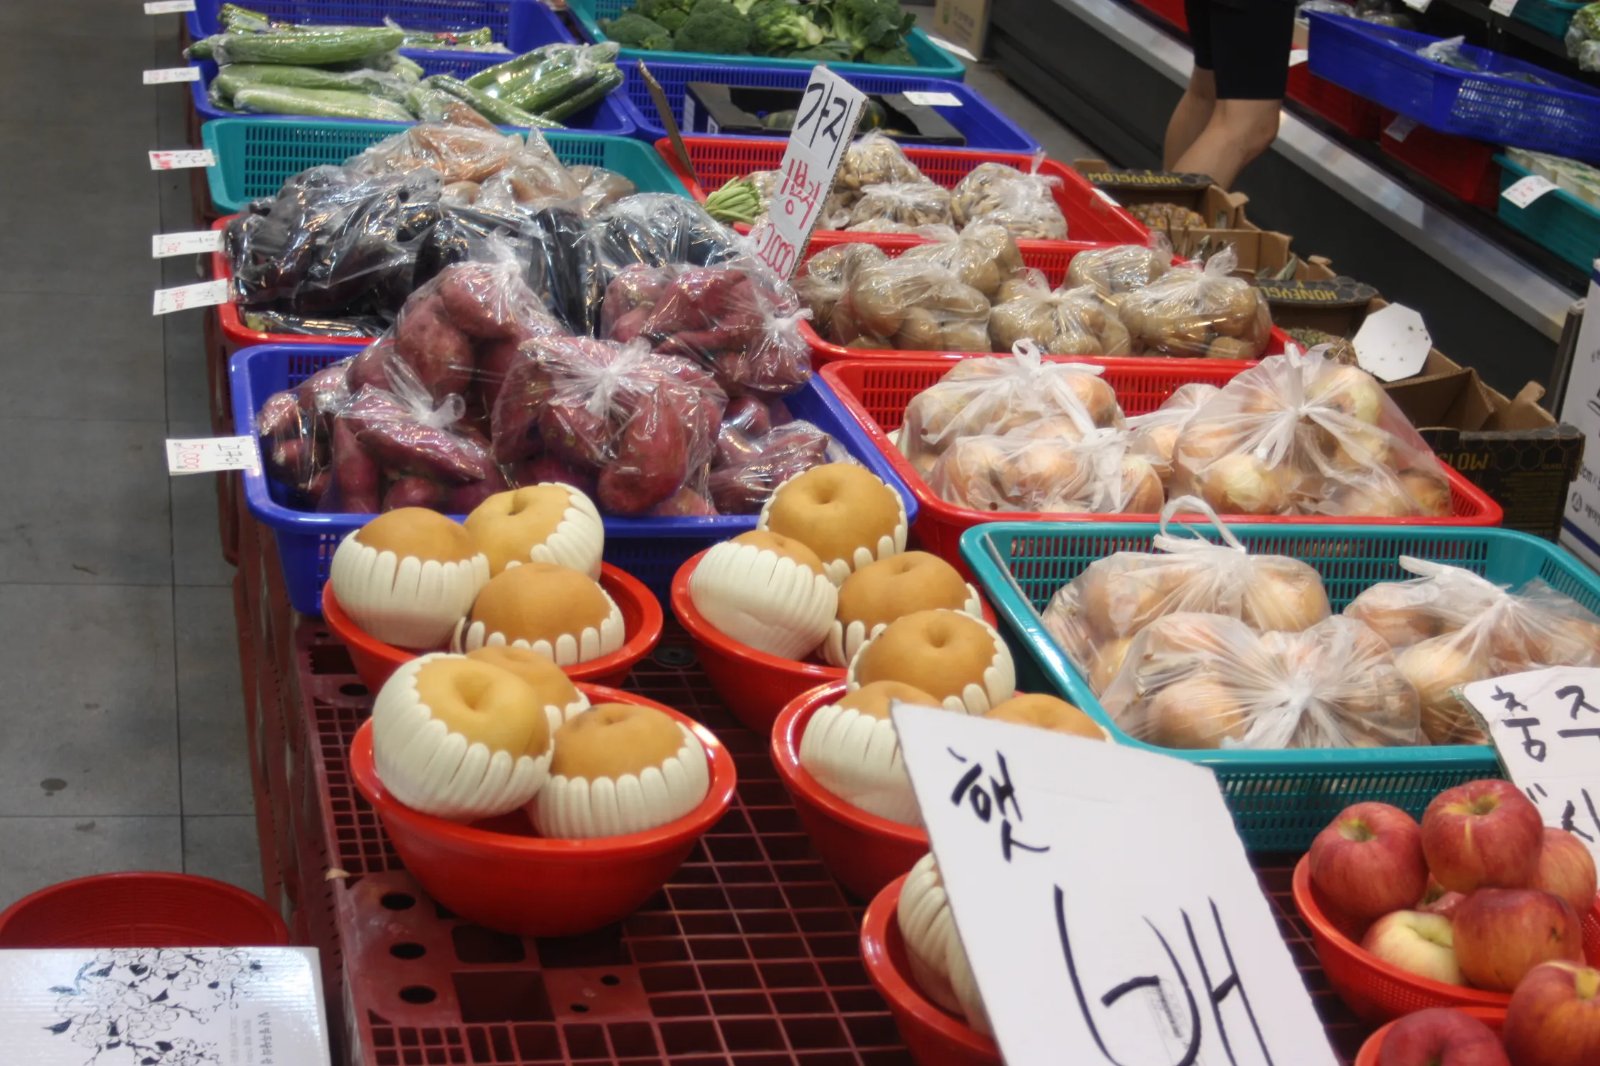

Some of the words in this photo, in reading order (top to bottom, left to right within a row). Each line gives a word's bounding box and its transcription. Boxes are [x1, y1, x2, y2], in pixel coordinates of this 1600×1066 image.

[797, 81, 853, 169] 가지
[758, 223, 796, 281] 2000
[946, 746, 1051, 863] 햇
